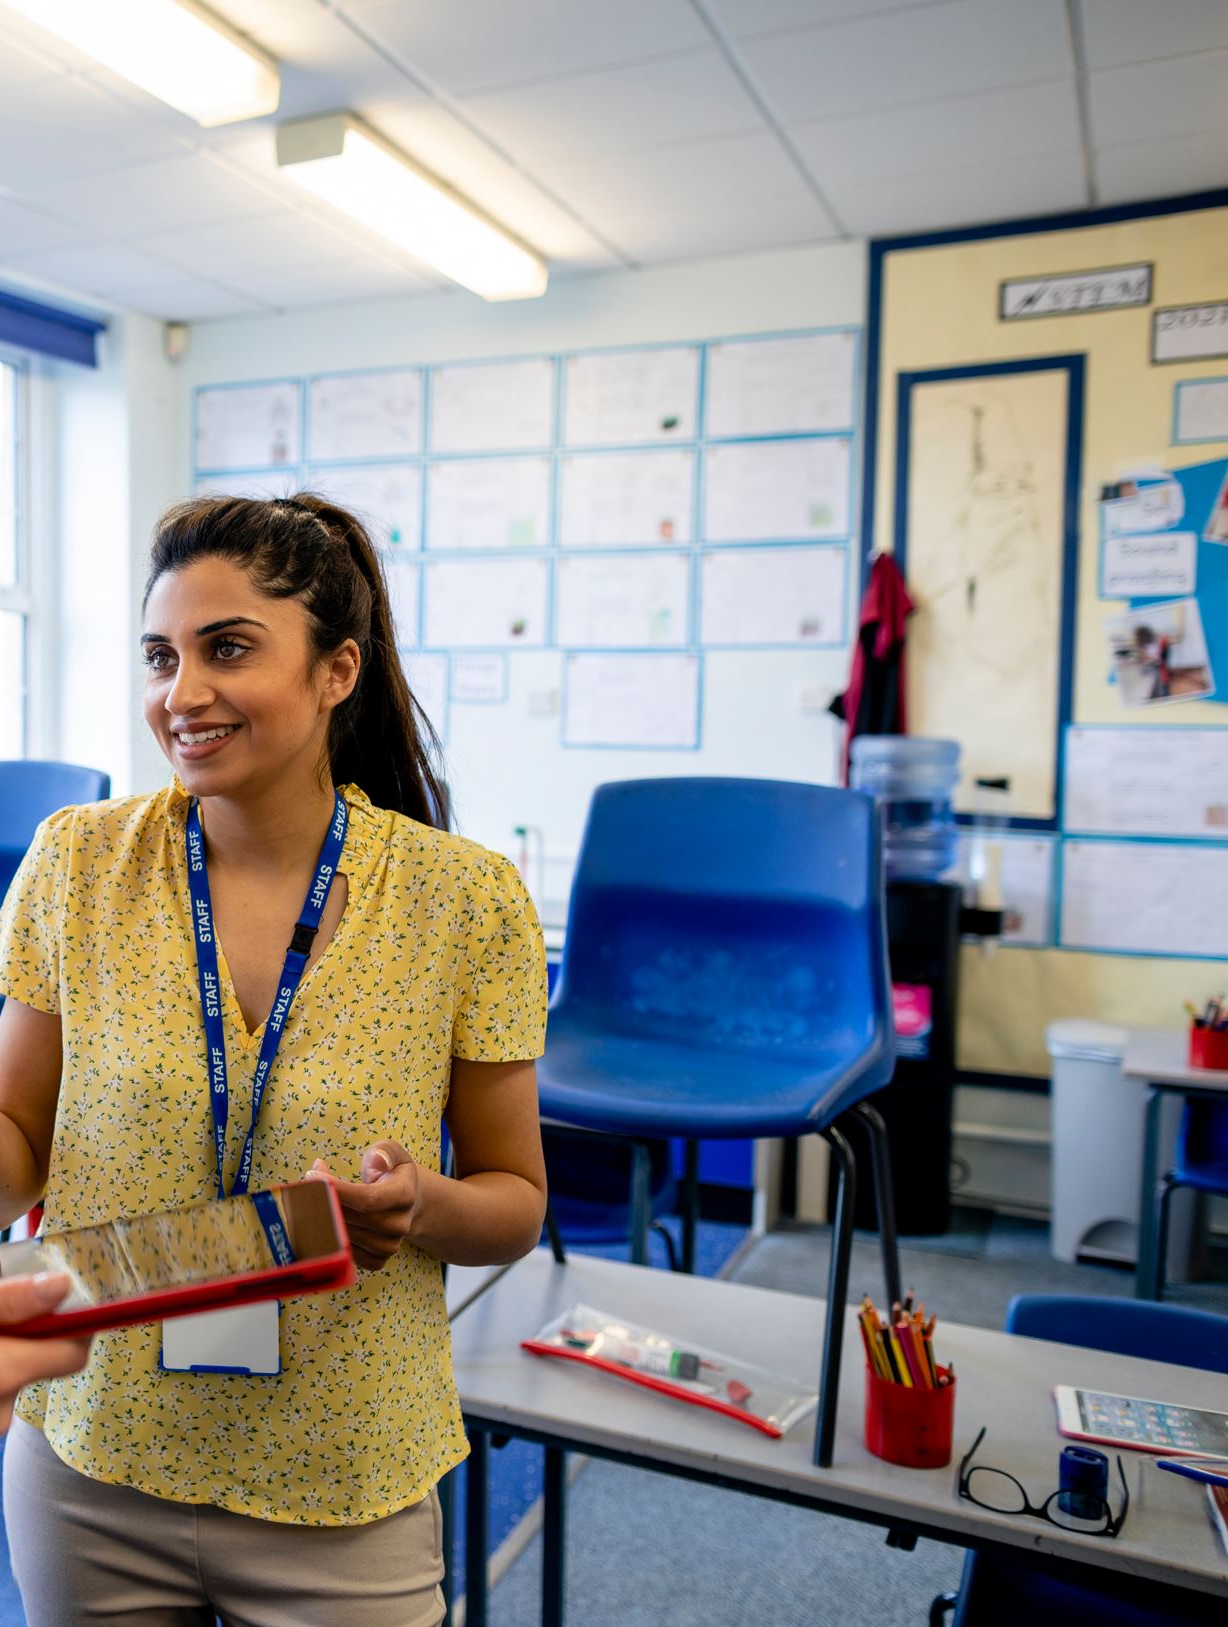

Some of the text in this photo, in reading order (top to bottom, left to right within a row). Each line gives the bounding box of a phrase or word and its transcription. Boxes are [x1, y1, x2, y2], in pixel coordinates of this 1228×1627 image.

[333, 801, 347, 841] STAFF
[189, 830, 203, 872] STAFF
[310, 864, 333, 909] STAFF
[196, 900, 212, 943] STAFF
[204, 972, 218, 1017] STAFF
[270, 986, 292, 1033] STAFF
[212, 1047, 225, 1094] STAFF
